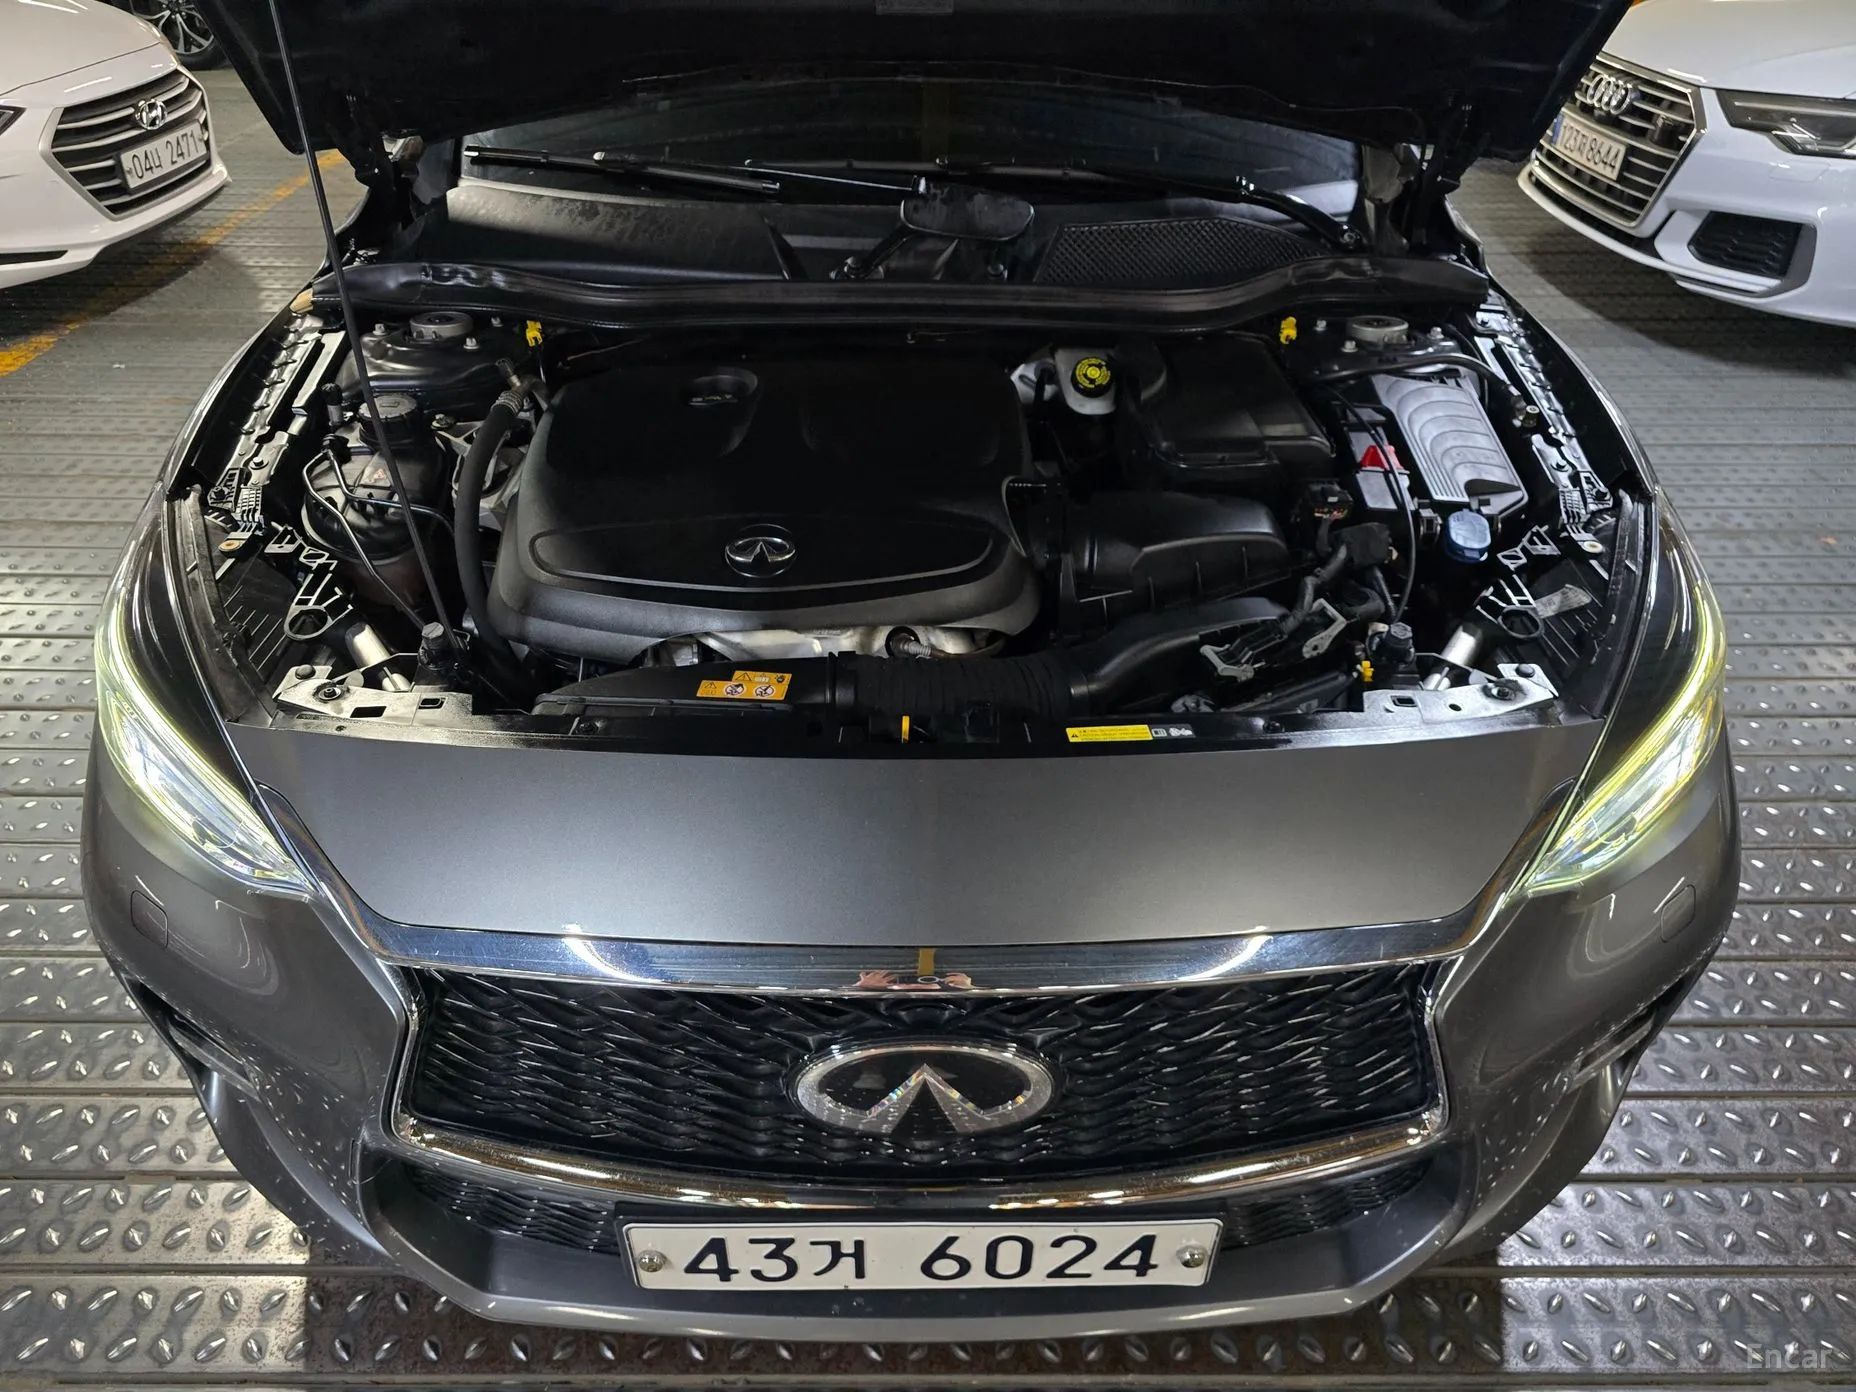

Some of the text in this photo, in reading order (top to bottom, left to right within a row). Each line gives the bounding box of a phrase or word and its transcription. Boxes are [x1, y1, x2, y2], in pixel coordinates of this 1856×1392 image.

[166, 130, 199, 165] 2471
[1587, 138, 1620, 174] 8644
[683, 1234, 1159, 1282] 43거 6024
